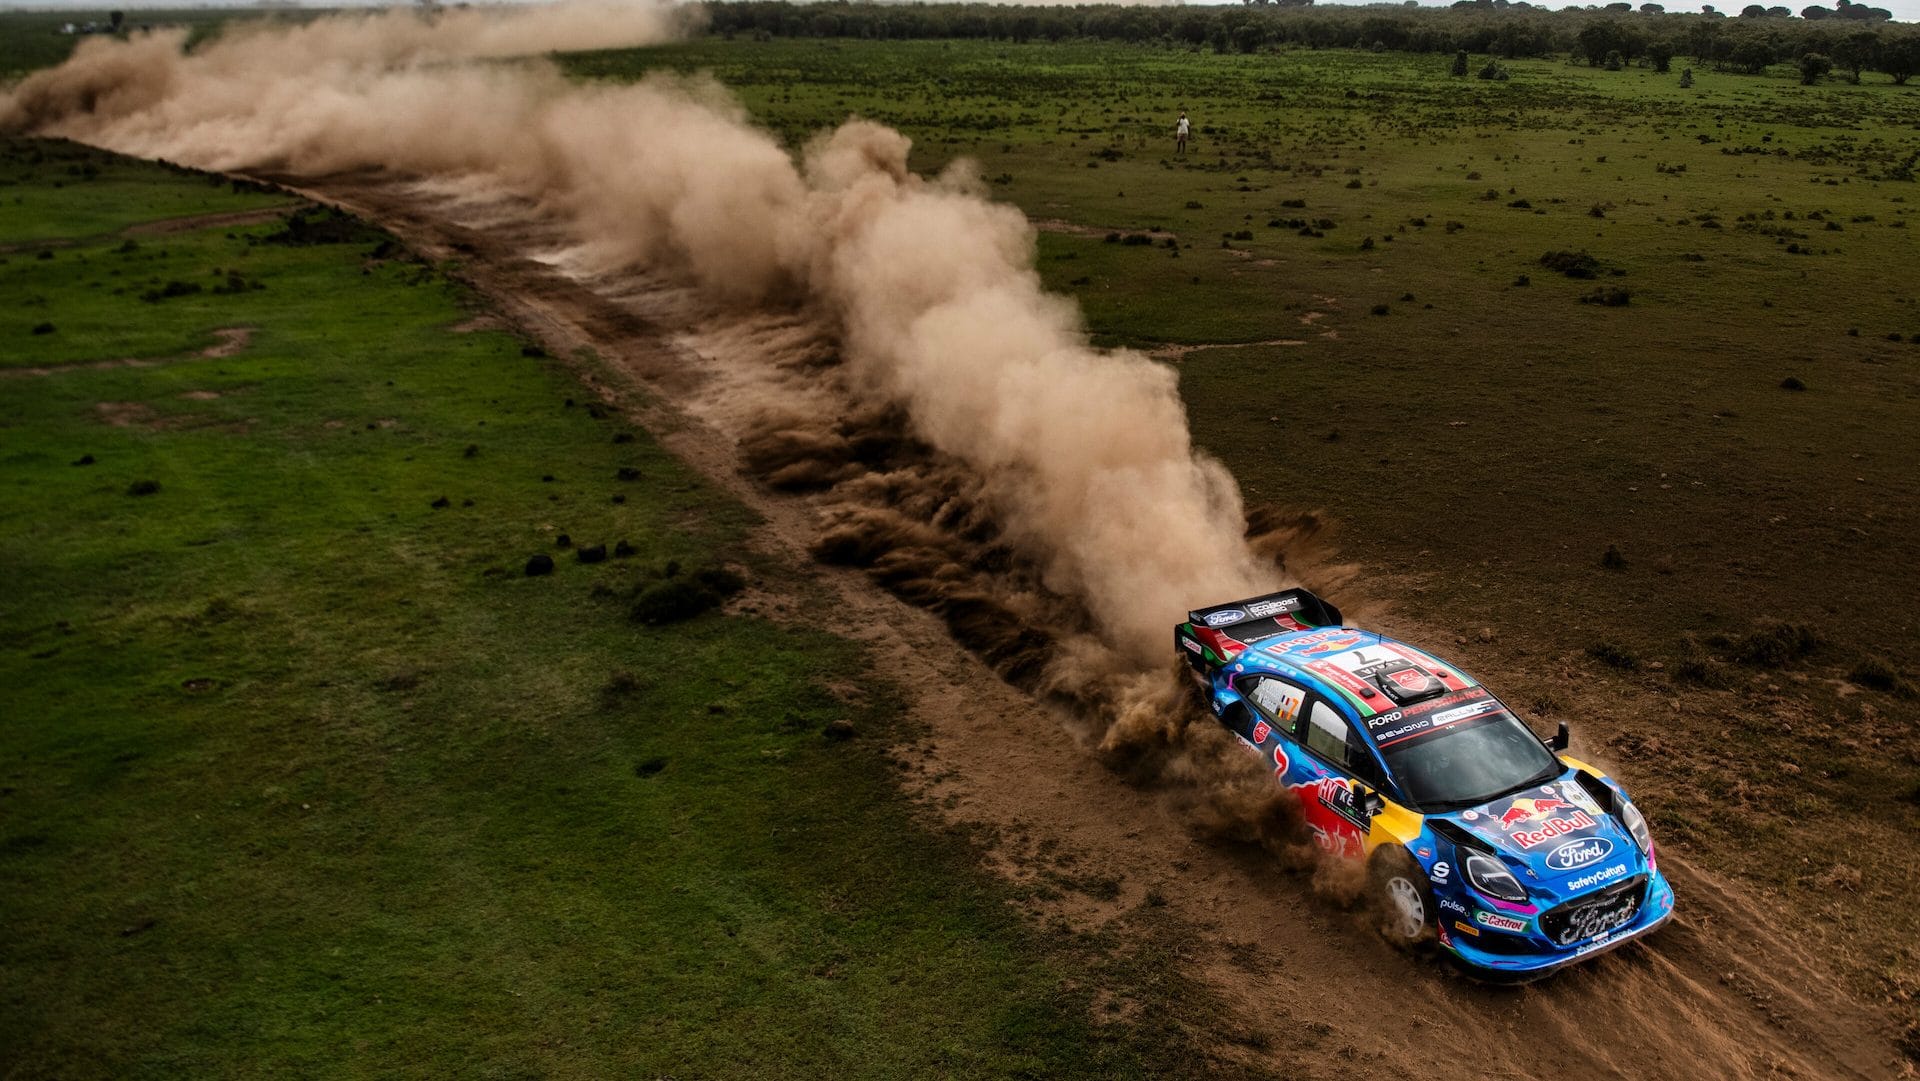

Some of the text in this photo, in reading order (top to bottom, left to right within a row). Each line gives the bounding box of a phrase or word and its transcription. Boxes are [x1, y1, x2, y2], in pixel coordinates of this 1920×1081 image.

[1210, 612, 1238, 625] Ford
[1368, 711, 1402, 729] FORD
[1401, 687, 1488, 717] PERFORMANCE
[1376, 720, 1430, 741] BEYOND
[1320, 778, 1337, 803] HY
[1512, 810, 1597, 849] Red Bull
[1558, 841, 1604, 867] Ford
[1568, 863, 1627, 891] SafetyCulture
[1440, 899, 1466, 914] pulse
[1487, 914, 1524, 931] Castrol
